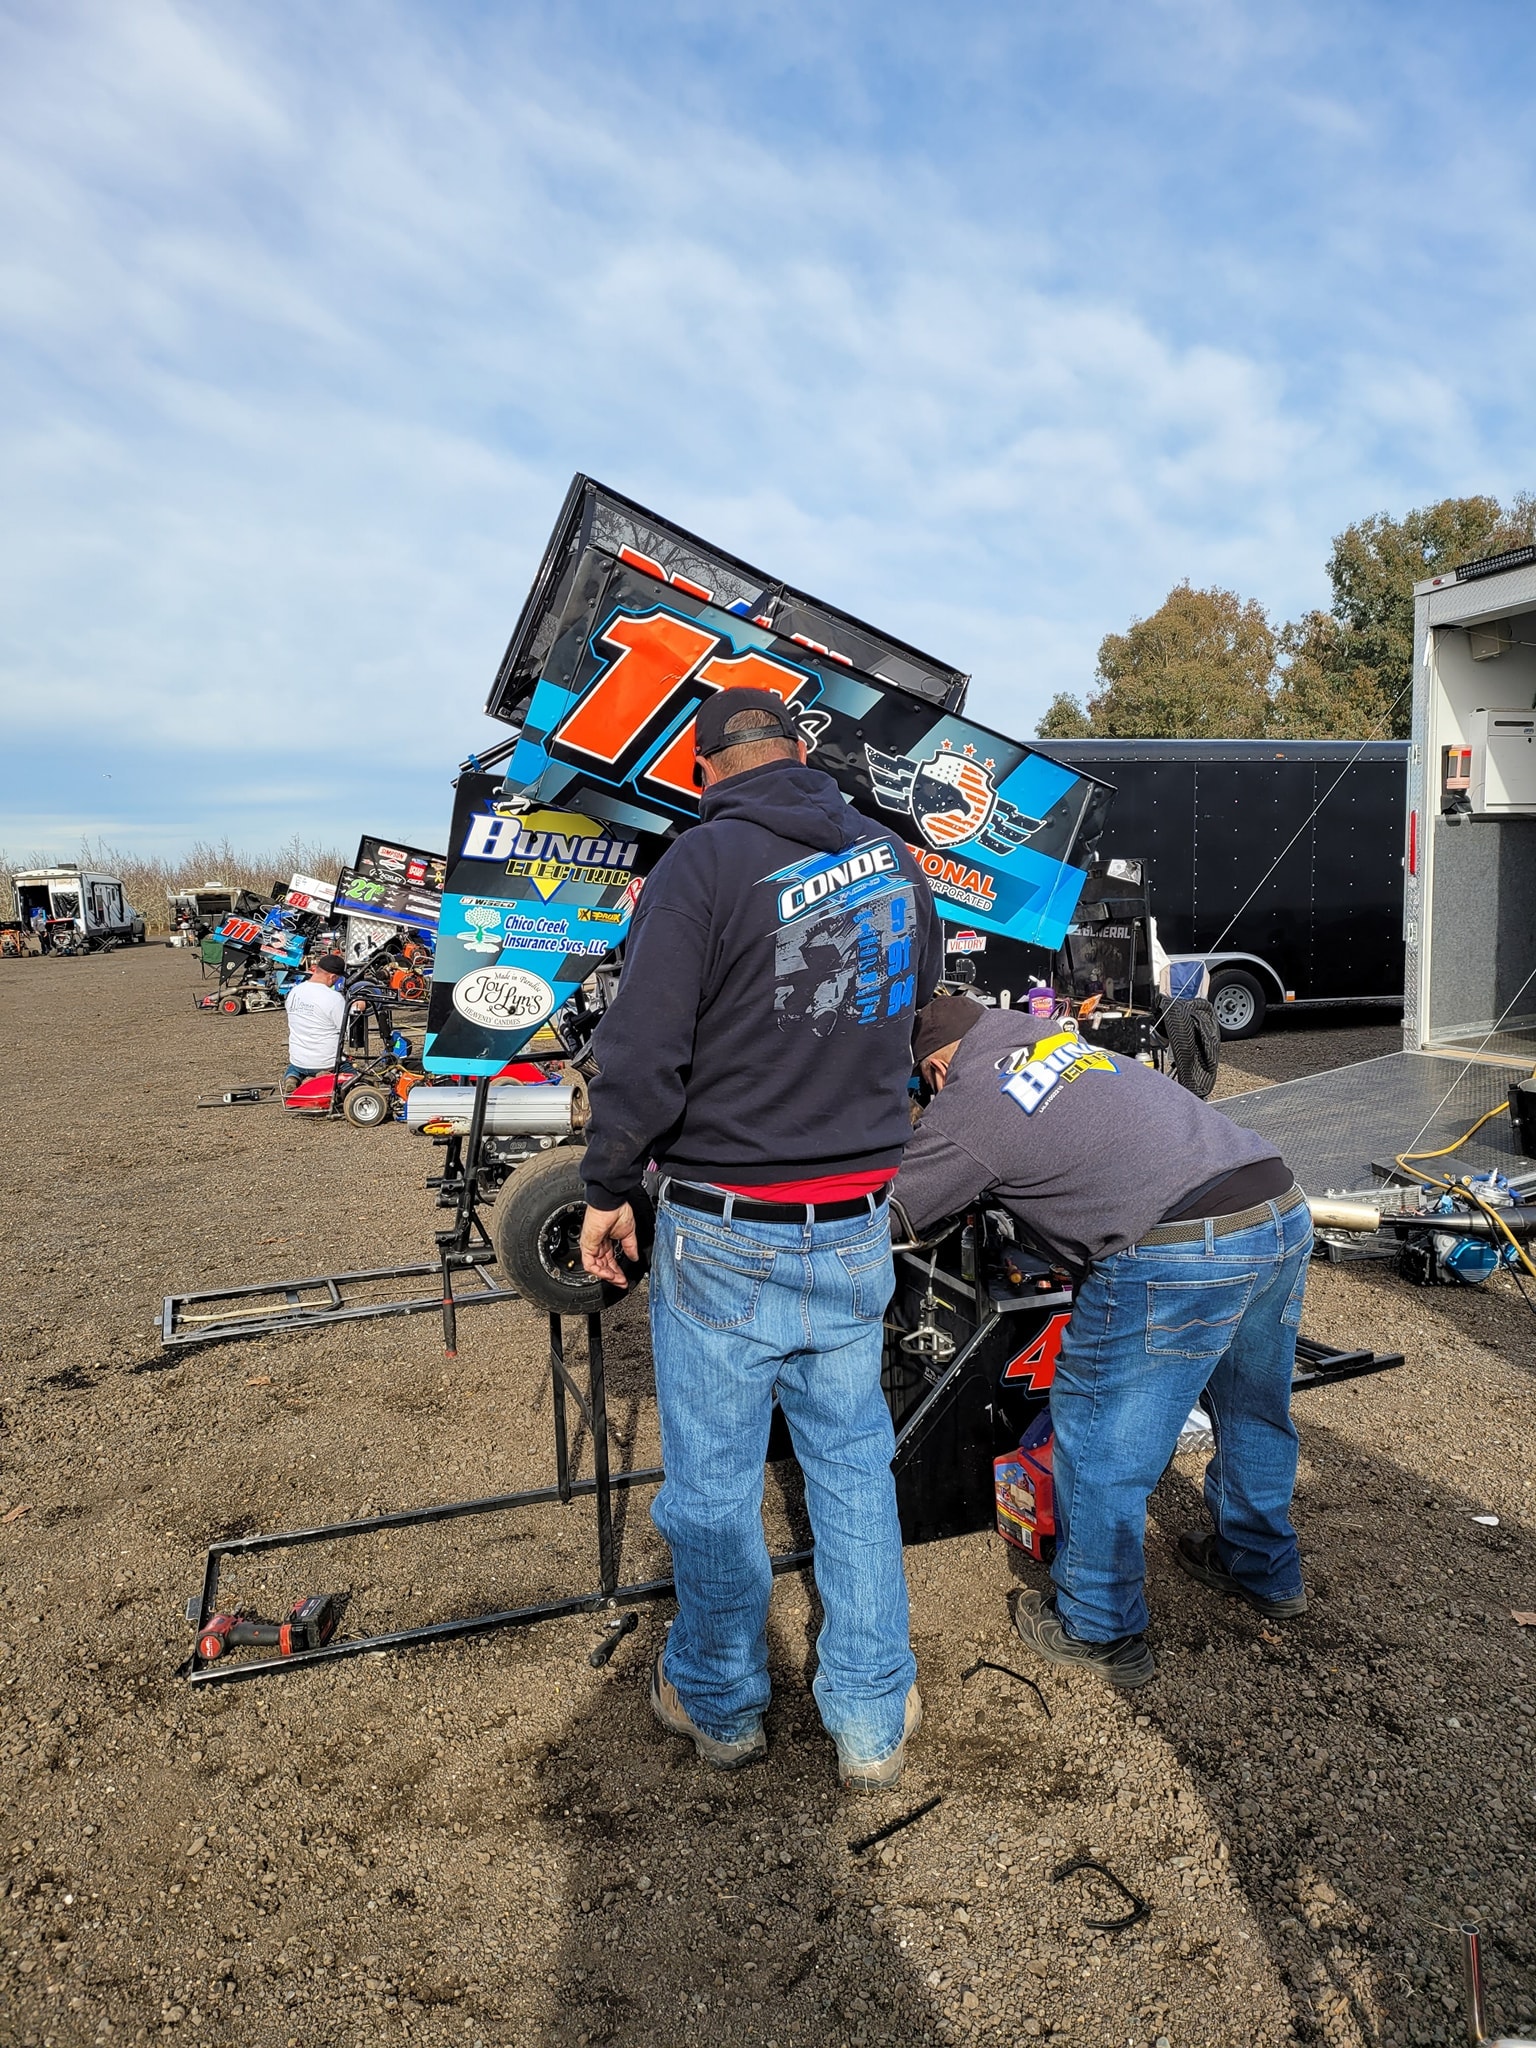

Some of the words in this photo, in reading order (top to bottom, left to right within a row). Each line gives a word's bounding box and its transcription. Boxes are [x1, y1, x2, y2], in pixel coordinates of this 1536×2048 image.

[462, 814, 639, 868] BUNCH
[380, 848, 404, 860] SIMPSON
[505, 860, 631, 886] ELECTRIC
[781, 845, 895, 919] CONDE
[927, 880, 992, 911] ORPORATED
[221, 918, 261, 943] 111
[505, 916, 535, 931] Chico
[537, 919, 567, 933] Creek
[504, 934, 556, 951] Insurance
[559, 939, 585, 955] Svcs,
[589, 941, 607, 954] LLC
[950, 940, 984, 951] VICTORY
[464, 1006, 493, 1025] HEAVENLY
[494, 1017, 521, 1026] CANDIES
